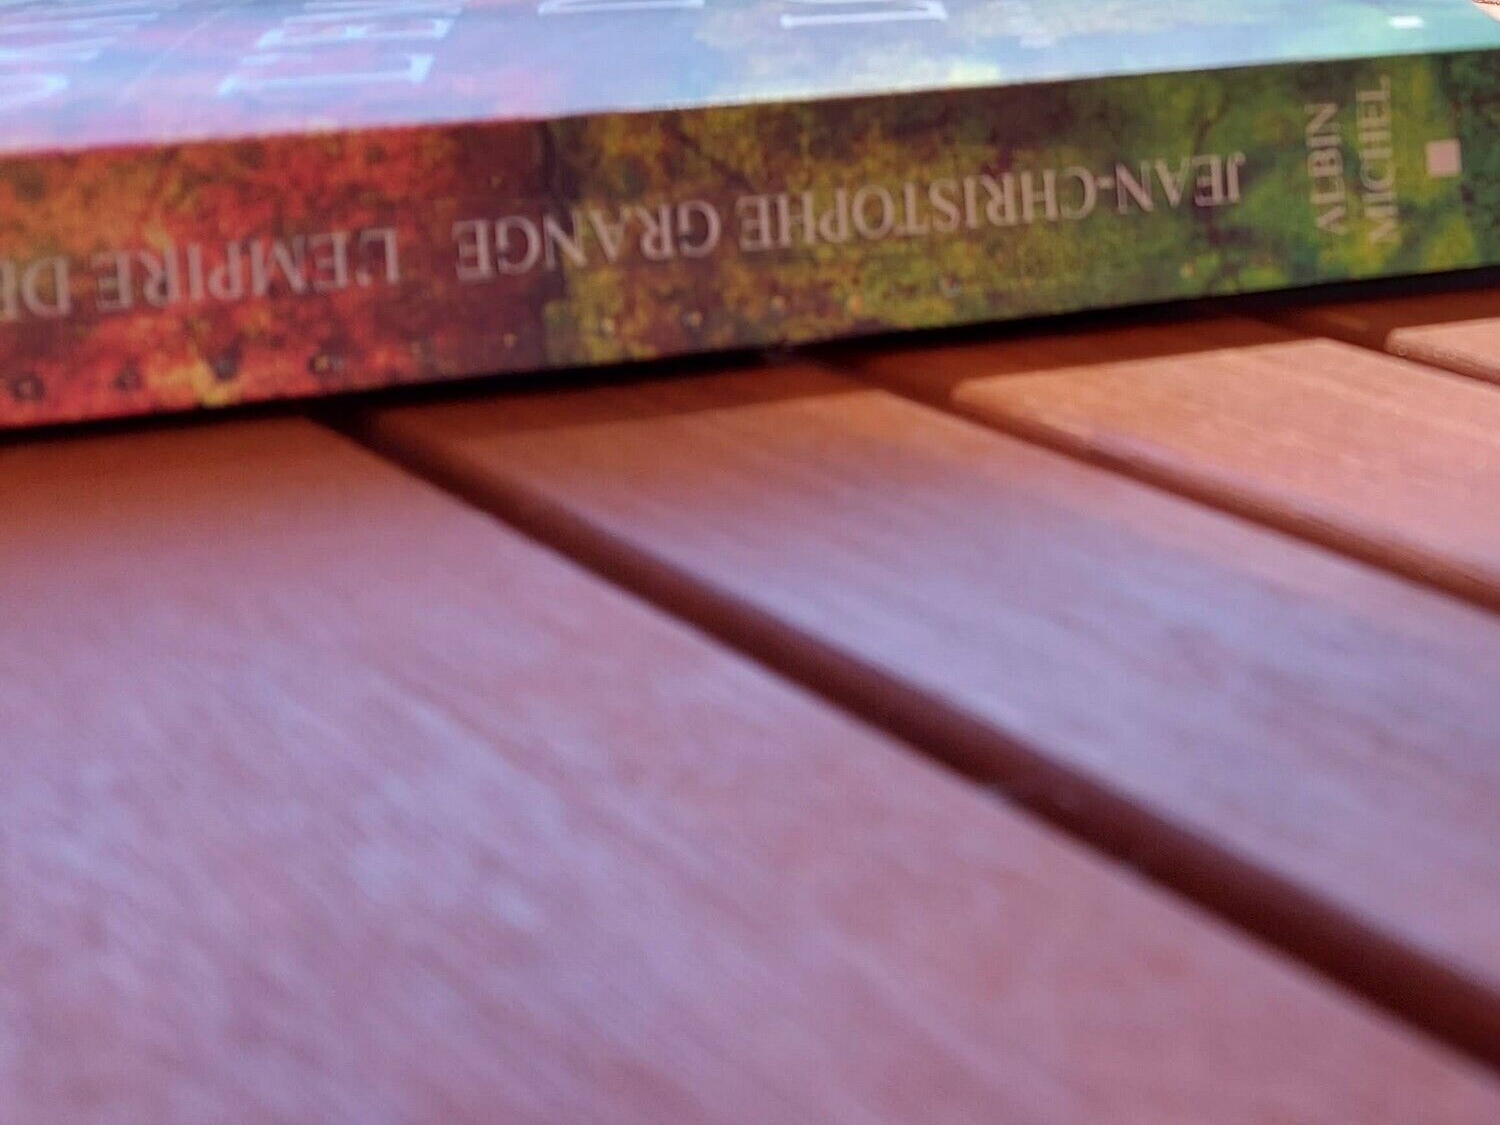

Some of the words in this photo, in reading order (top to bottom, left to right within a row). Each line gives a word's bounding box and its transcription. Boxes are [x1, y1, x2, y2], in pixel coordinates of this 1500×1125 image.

[738, 152, 1246, 253] JEAN-CHRISTOPHE
[1304, 102, 1348, 236] ALBIN
[1356, 75, 1401, 244] MICHEL
[94, 226, 399, 315] L'EMPIRE
